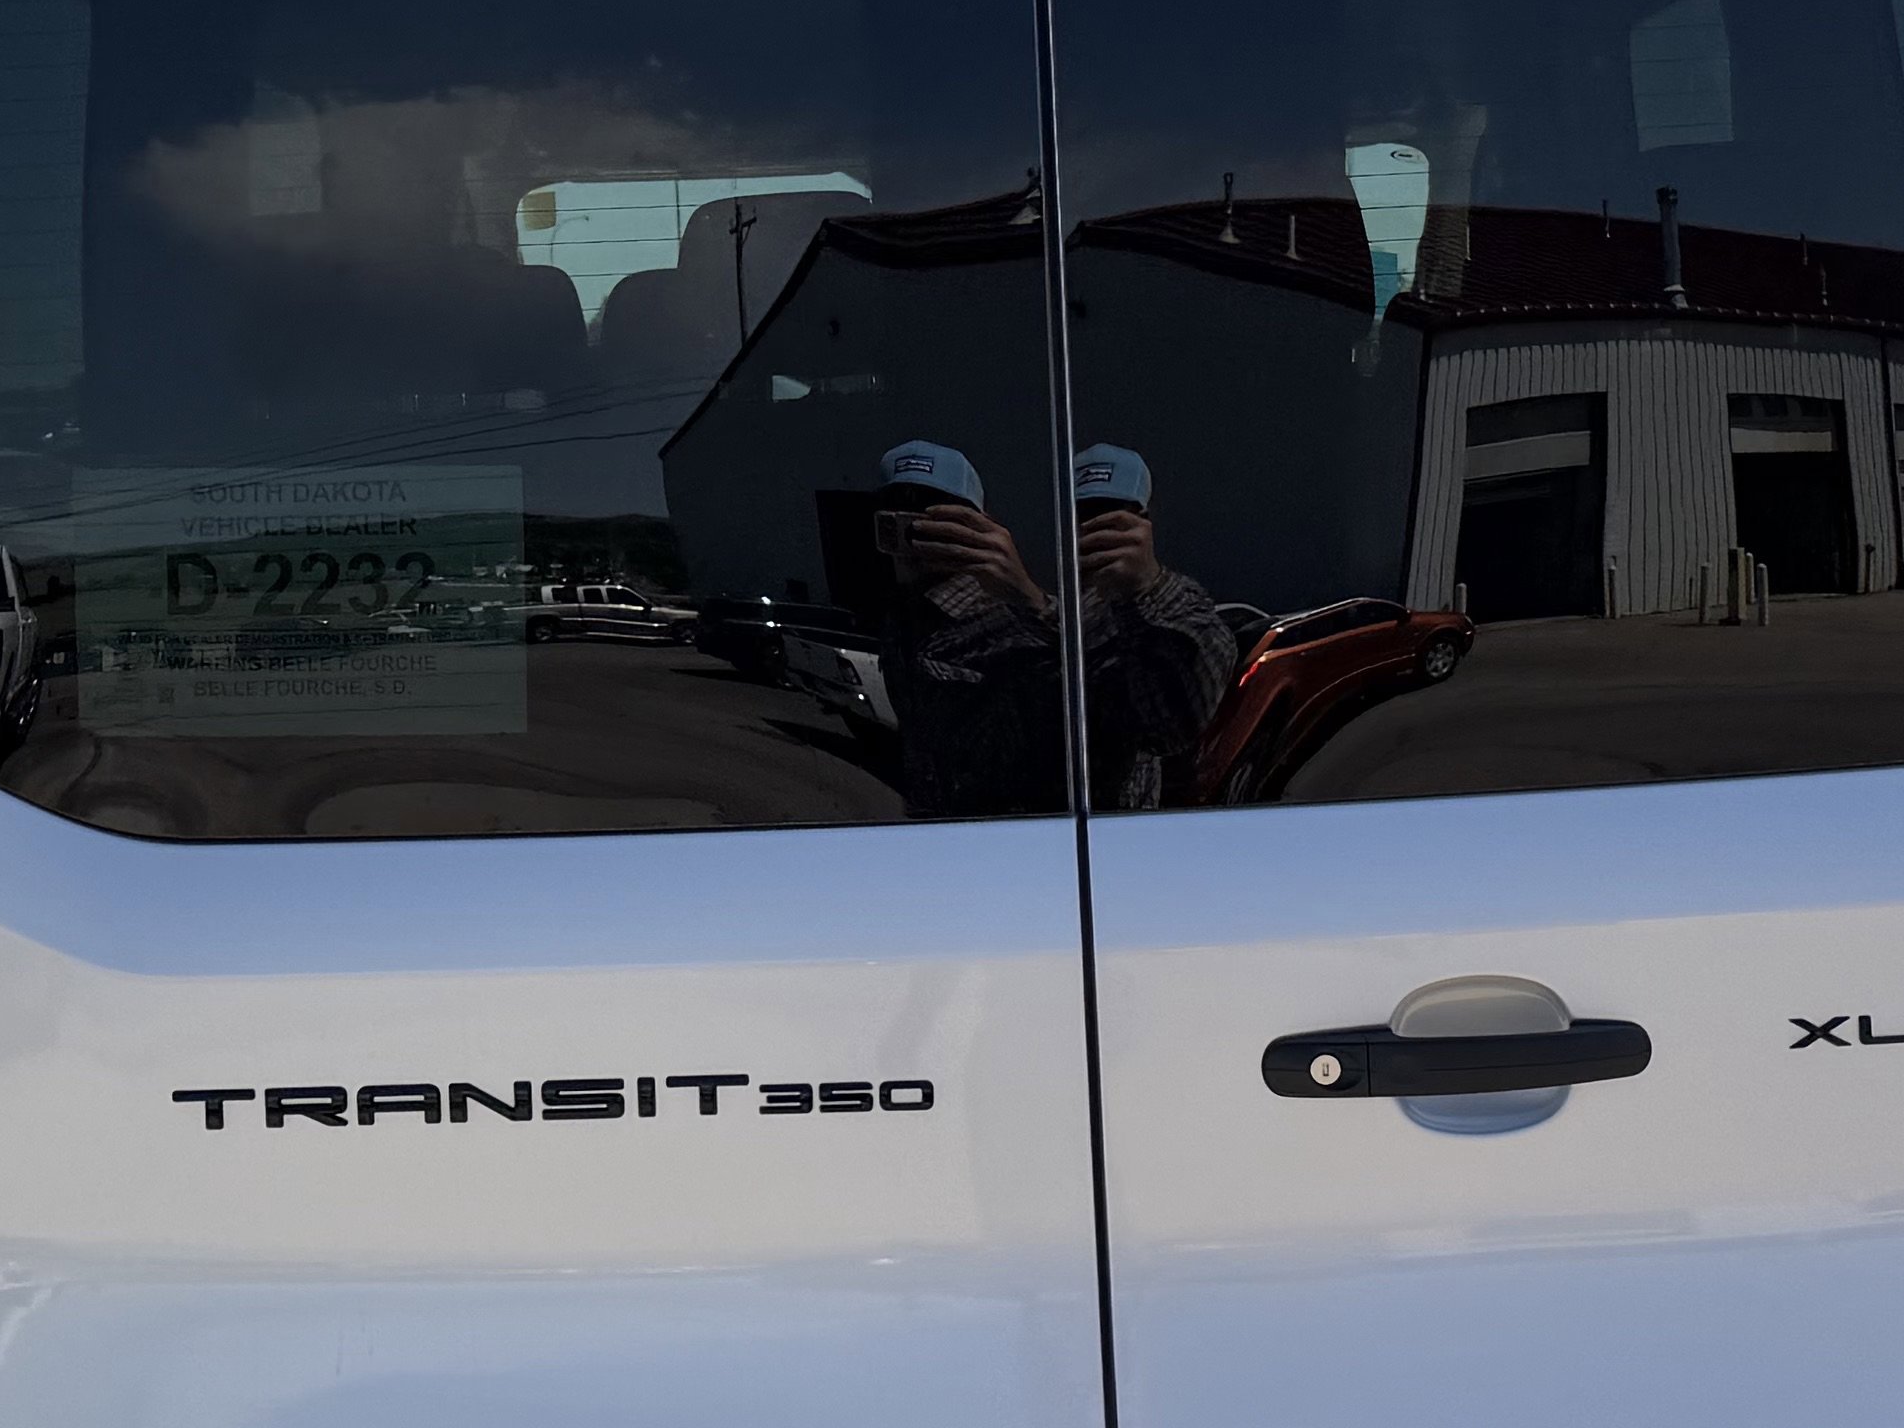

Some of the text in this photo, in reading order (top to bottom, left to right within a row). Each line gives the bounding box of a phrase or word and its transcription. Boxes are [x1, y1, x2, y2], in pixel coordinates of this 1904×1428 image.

[192, 481, 406, 504] SOUTH DAKOTA
[180, 514, 417, 538] VEHICLE DEALER
[166, 550, 436, 617] D-2232
[339, 654, 436, 671] FOURCHE
[194, 680, 258, 697] BELLE
[172, 1074, 935, 1130] TRANSIT 350
